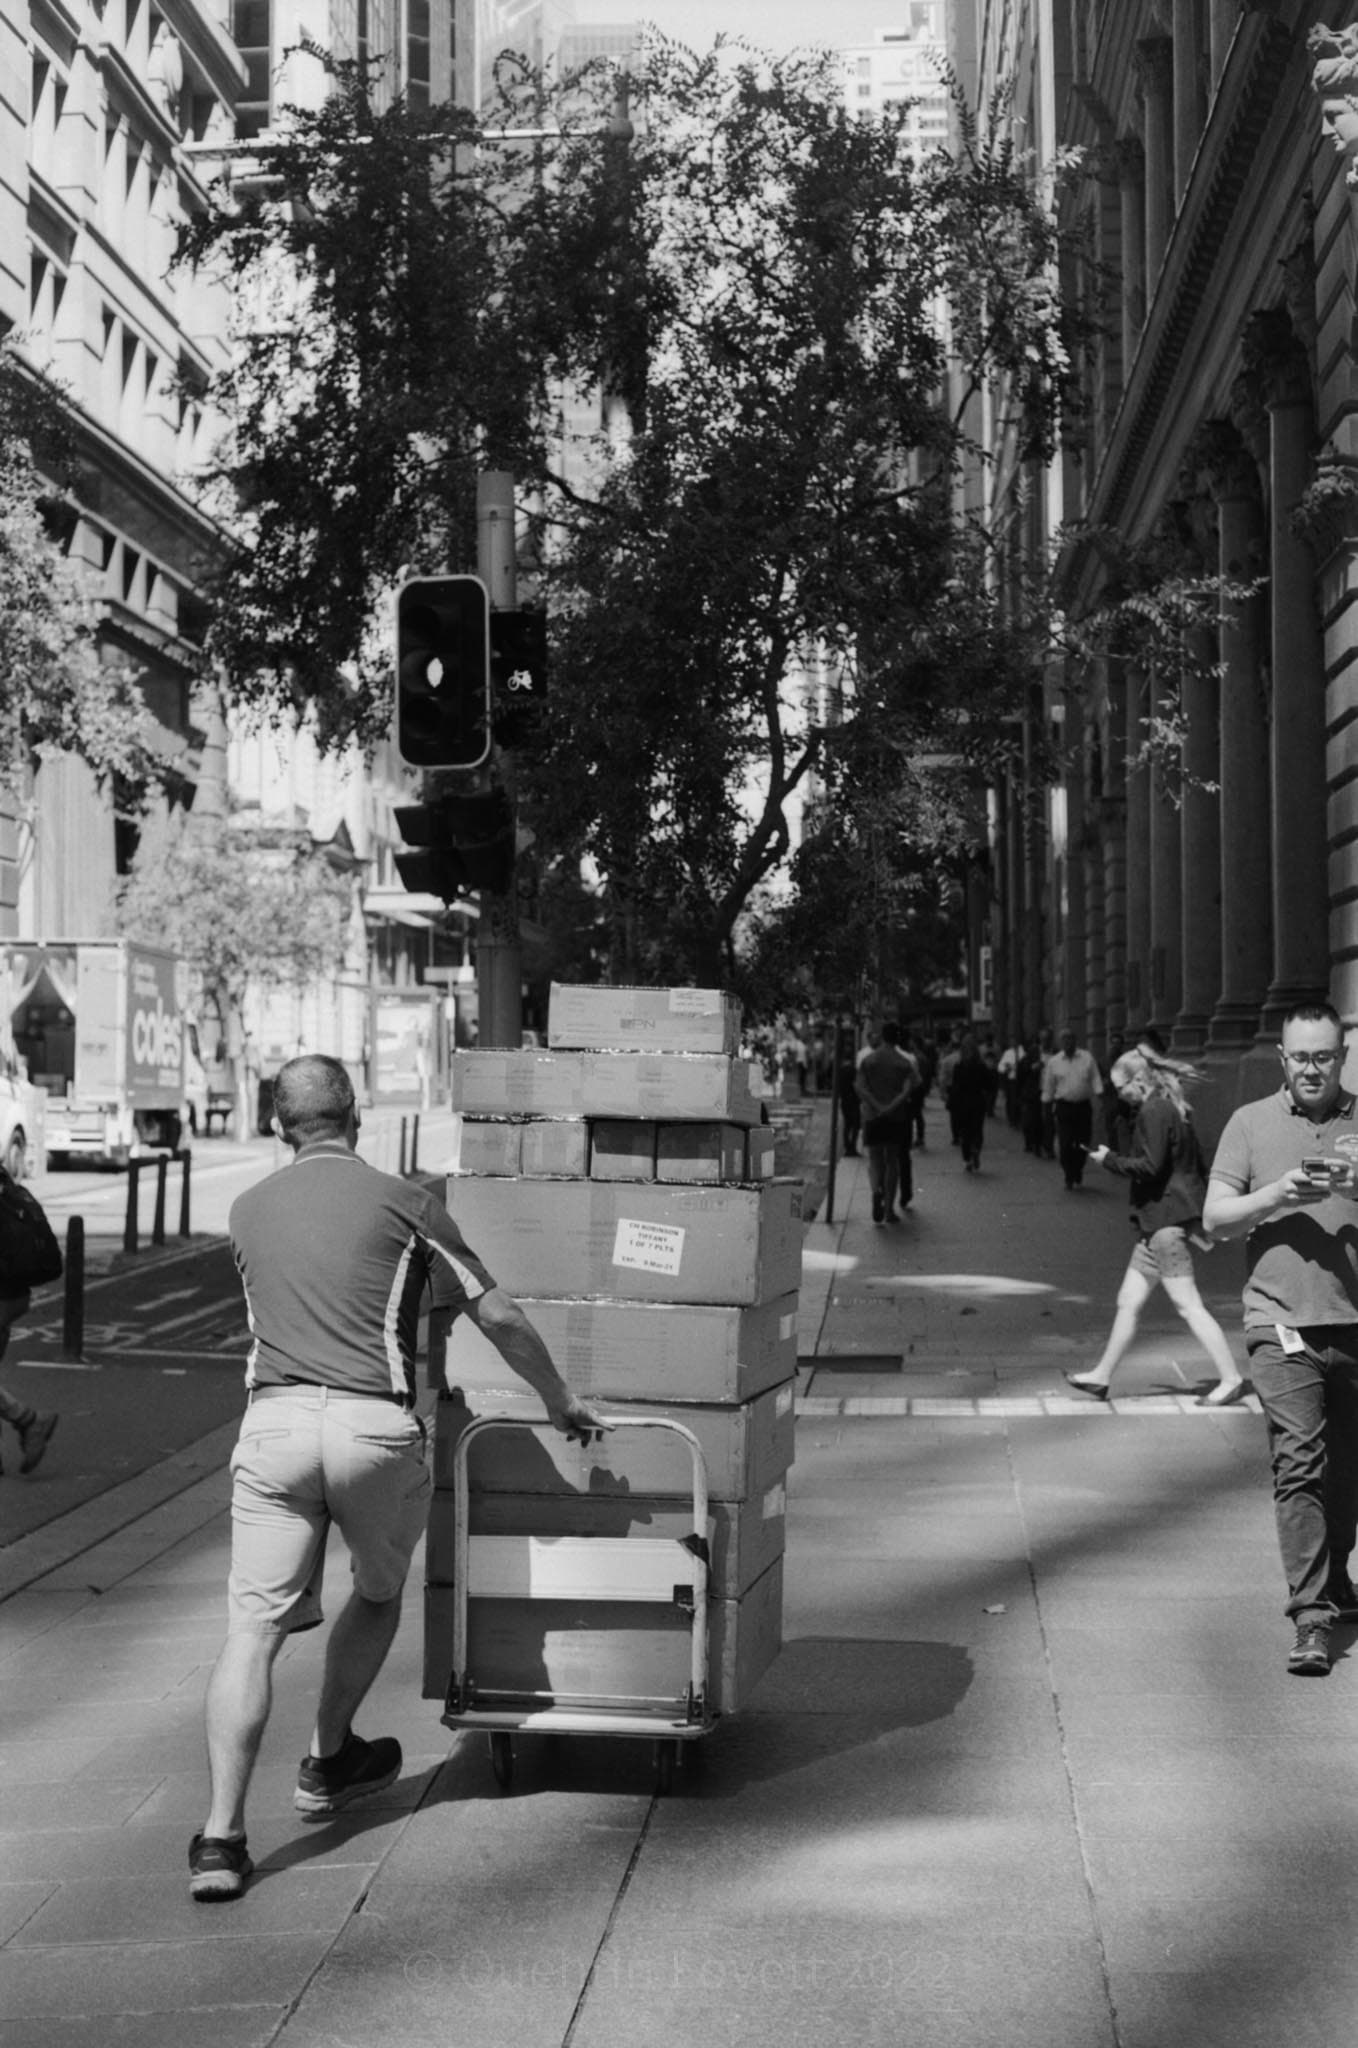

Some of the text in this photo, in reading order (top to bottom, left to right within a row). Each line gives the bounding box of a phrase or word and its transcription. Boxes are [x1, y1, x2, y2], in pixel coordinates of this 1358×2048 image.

[133, 996, 182, 1068] coles
[641, 1225, 679, 1236] ROBINSON
[638, 1232, 668, 1243] TIFFANY
[635, 1240, 645, 1248] OF
